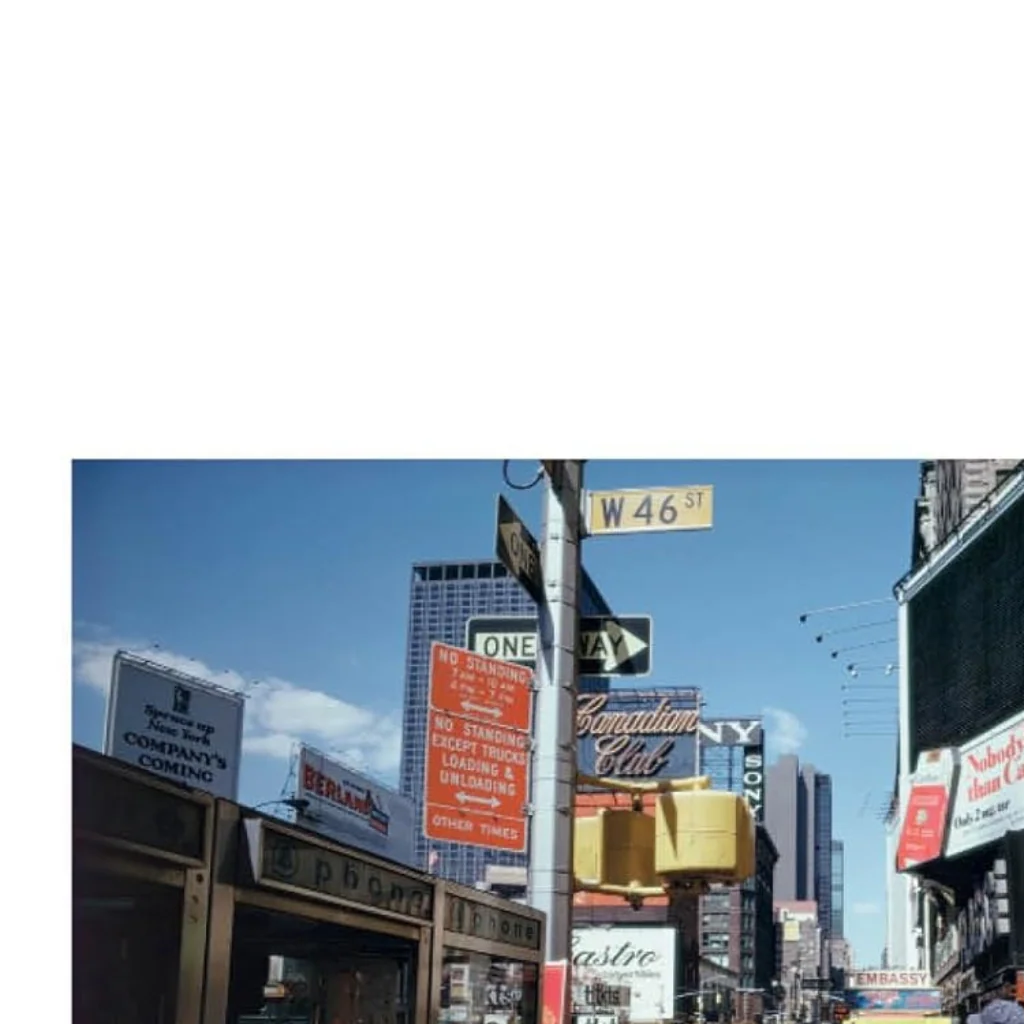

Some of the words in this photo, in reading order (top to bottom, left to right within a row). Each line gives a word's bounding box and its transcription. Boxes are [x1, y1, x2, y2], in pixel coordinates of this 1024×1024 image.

[601, 497, 624, 528] W
[633, 495, 678, 525] 46
[685, 492, 704, 509] ST
[483, 636, 536, 657] ONE
[440, 648, 458, 665] NO
[467, 657, 527, 684] STANDING
[576, 694, 699, 735] Canadian
[434, 716, 453, 731] NO
[463, 722, 527, 749] STANDING
[123, 731, 227, 770] COMPANY'S
[431, 733, 477, 756] EXCEPT
[482, 744, 526, 765] TRUCKS
[442, 752, 499, 777] LOADING
[595, 734, 676, 775] Club
[138, 753, 214, 783] COMING
[439, 769, 517, 797] UNLOADING
[743, 755, 764, 823] SONY
[432, 814, 474, 831] OTHER
[480, 823, 520, 840] TIMES
[473, 911, 535, 941] phone
[857, 972, 929, 986] EMBASSY
